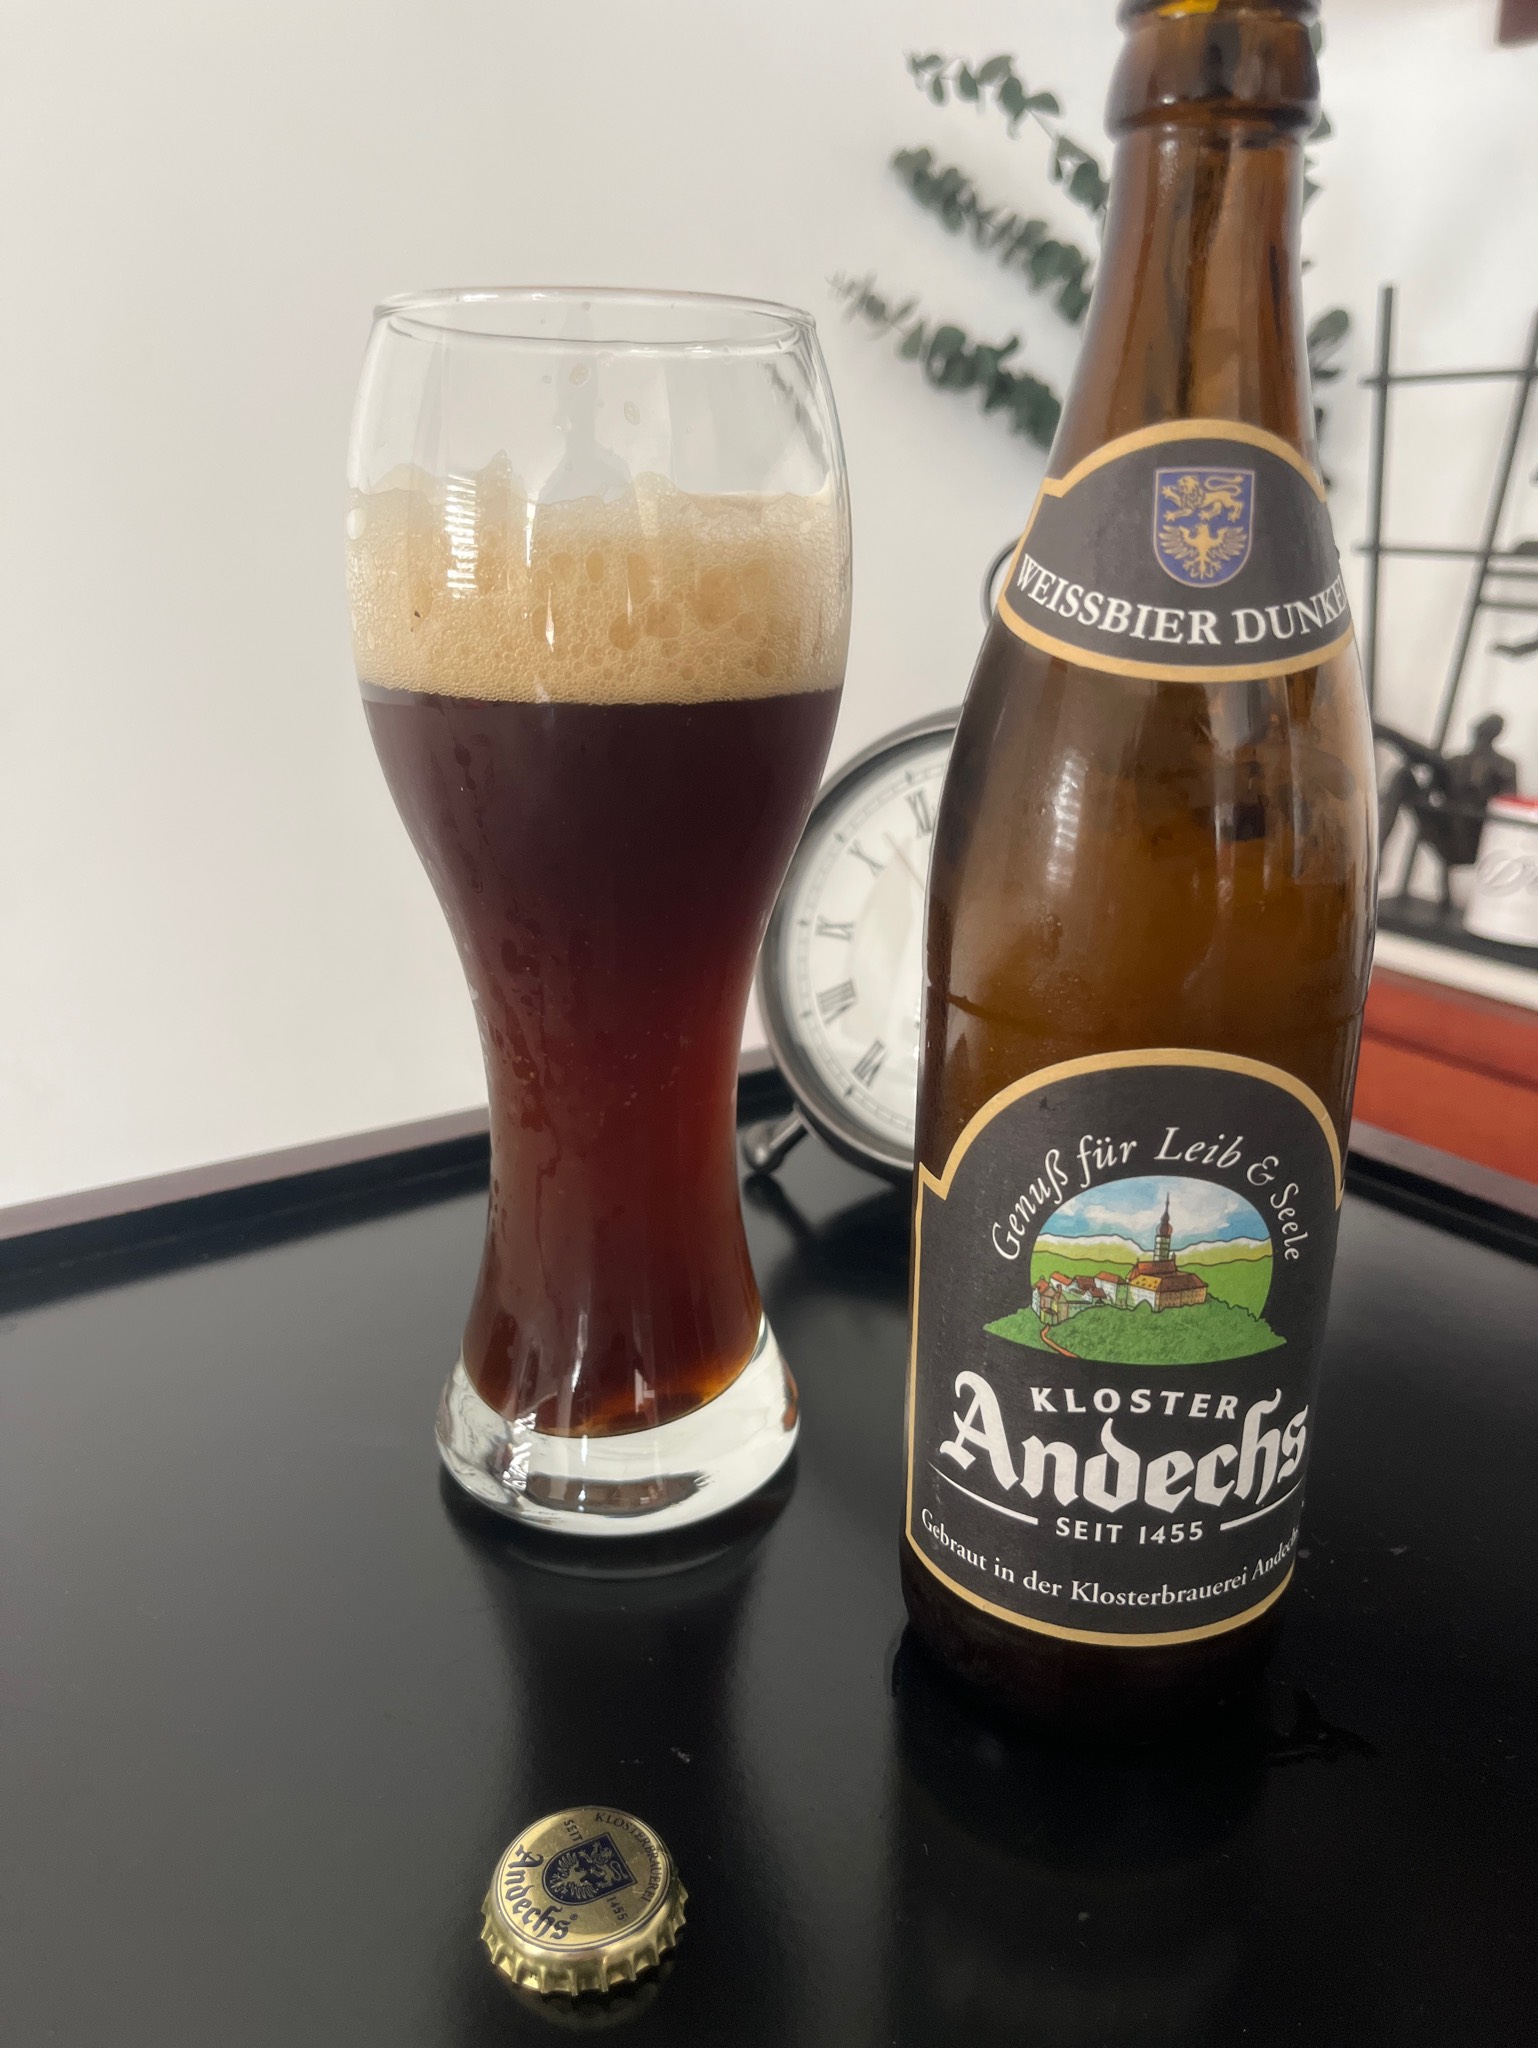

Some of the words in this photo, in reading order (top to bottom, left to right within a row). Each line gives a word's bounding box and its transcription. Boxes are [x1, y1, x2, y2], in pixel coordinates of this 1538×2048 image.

[1016, 553, 1221, 645] WEISSBIER
[1231, 573, 1347, 645] DUNKE
[992, 1148, 1069, 1260] Genuß
[1076, 1134, 1138, 1189] für
[1154, 1127, 1244, 1169] Leib
[1246, 1155, 1279, 1187] &
[1270, 1182, 1308, 1261] Seele
[939, 1370, 1309, 1513] Andechs
[1030, 1386, 1239, 1420] KLOSTER
[921, 1508, 987, 1572] Gebraut
[994, 1556, 1015, 1584] in
[1022, 1571, 1062, 1598] der
[1071, 1566, 1247, 1606] Klosterbrauerei
[1251, 1525, 1299, 1581] Andech
[1056, 1516, 1123, 1543] SEIT
[1139, 1520, 1203, 1545] 1455
[504, 1844, 571, 1940] Andechs
[564, 1819, 583, 1842] SEIT
[606, 1896, 628, 1921] 1455
